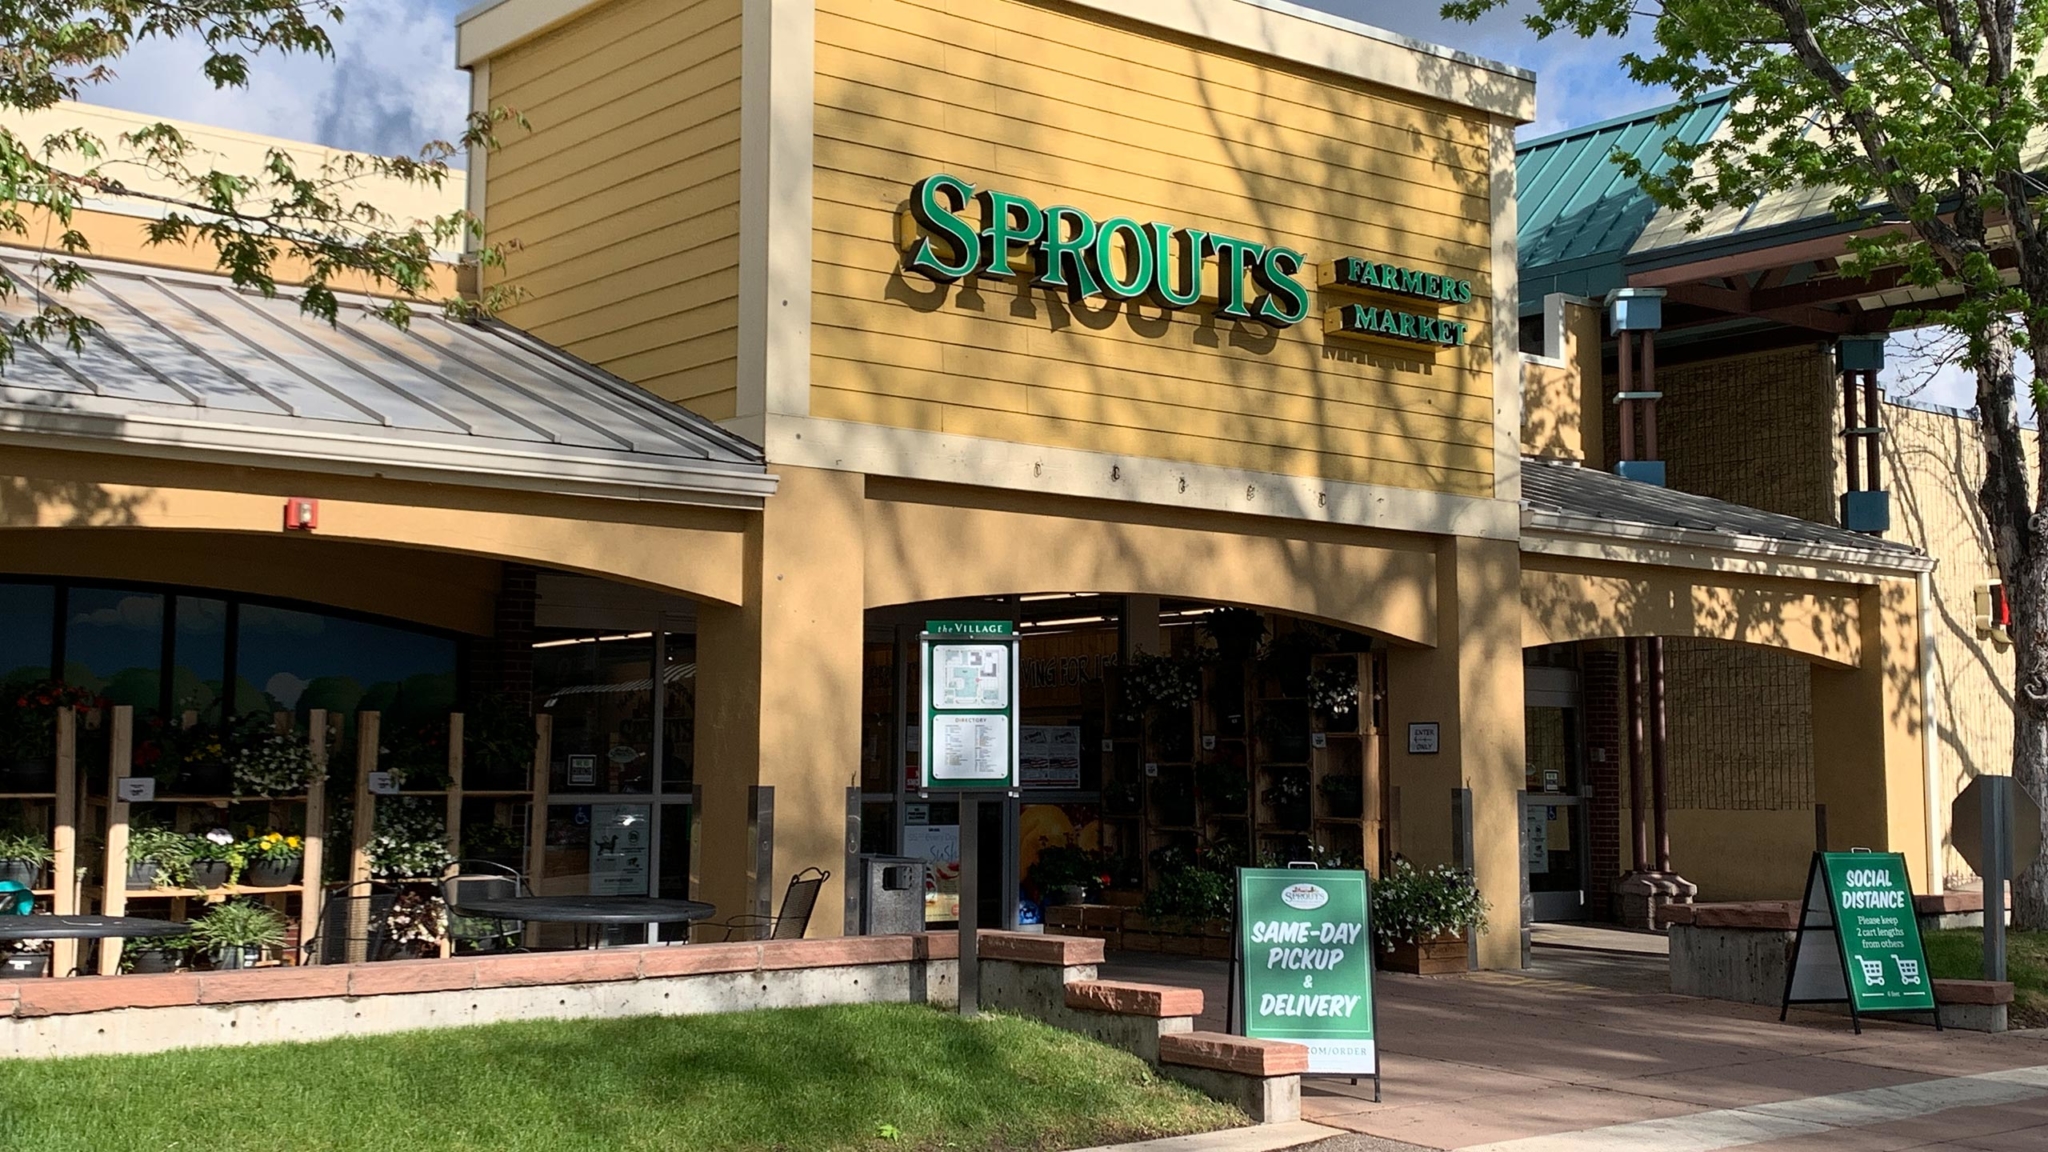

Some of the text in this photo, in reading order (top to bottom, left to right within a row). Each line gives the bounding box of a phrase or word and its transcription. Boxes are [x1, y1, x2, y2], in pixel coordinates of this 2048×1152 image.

[911, 173, 1311, 325] SPROUTS
[1347, 256, 1472, 305] FARMERS
[1353, 303, 1468, 347] MARKET
[937, 622, 1003, 633] the VILLAGE
[1019, 656, 1057, 689] VING
[1846, 869, 1892, 887] SOCIAL
[1285, 891, 1325, 902] SPROUTS
[1842, 890, 1905, 909] DISTANCE
[1857, 915, 1898, 927] Please keep
[1251, 921, 1362, 945] SAME-DAY
[1857, 927, 1904, 939] 2 cart lengths
[1862, 939, 1904, 948] from others
[1267, 947, 1344, 970] PICKUP
[1303, 975, 1313, 988] &
[1259, 993, 1361, 1017] DELIVERY
[1308, 1046, 1367, 1056] OM/ORDER
